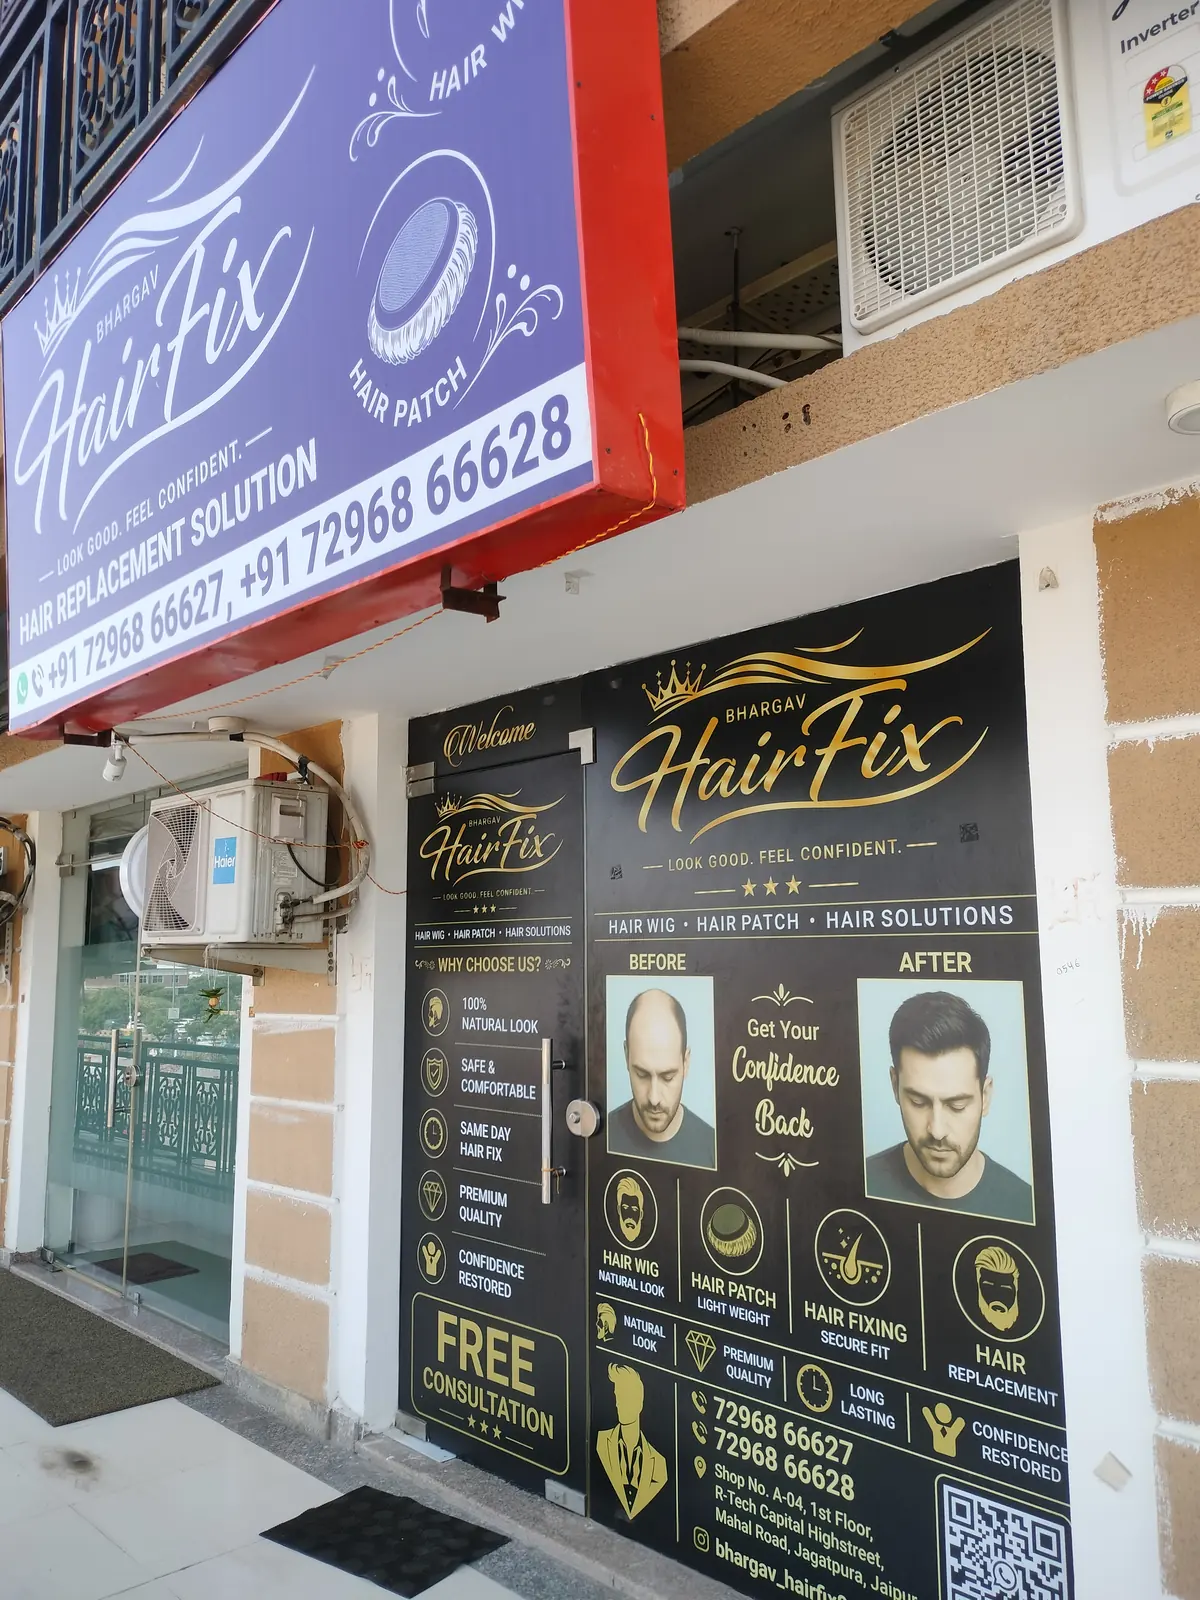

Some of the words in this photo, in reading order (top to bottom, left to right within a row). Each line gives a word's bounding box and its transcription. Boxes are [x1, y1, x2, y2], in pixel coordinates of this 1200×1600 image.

[1120, 0, 1200, 54] Inverter
[429, 43, 488, 102] HAIR
[96, 263, 159, 345] BHARGAV
[349, 358, 389, 424] HAIR
[393, 355, 468, 427] PATCH
[57, 543, 84, 577] LOOK
[87, 520, 122, 556] GOOD.
[126, 497, 153, 532] FEEL
[158, 439, 242, 509] CONFIDENT.
[19, 600, 53, 646] HAIR
[57, 516, 186, 625] REPLACEMENT
[191, 437, 317, 547] SOLUTION
[48, 645, 77, 689] +91
[83, 611, 144, 676] 72968
[150, 569, 232, 644] 66627,
[240, 536, 290, 599] +91
[301, 475, 414, 575] 72968
[426, 393, 572, 516] 66628
[725, 693, 806, 723] BHARGAV
[443, 705, 536, 768] Welcome
[468, 816, 501, 828] BHARGAV
[214, 854, 236, 869] Haier
[667, 856, 703, 872] LOOK
[708, 852, 755, 869] GOOD.
[759, 848, 795, 865] FEEL
[800, 838, 903, 862] CONFIDENT.
[443, 893, 458, 901] LOOK
[460, 892, 479, 900] GOOD.
[480, 890, 495, 898] FEEL
[495, 887, 534, 897] CONFIDENT.
[415, 931, 431, 941] HAIR
[431, 930, 445, 941] WIG
[453, 929, 471, 940] HAIR
[471, 927, 496, 939] PATCH
[505, 927, 524, 938] HAIR
[525, 925, 571, 937] SOLUTIONS
[608, 916, 644, 935] HAIR
[647, 916, 676, 934] WIG
[696, 914, 737, 933] HAIR
[741, 912, 800, 931] PATCH
[825, 907, 876, 930] HAIR
[880, 904, 1014, 929] SOLUTIONS
[438, 957, 464, 973] WHY
[466, 956, 515, 973] CHOOSE
[518, 955, 542, 972] US?
[628, 952, 687, 971] BEFORE
[898, 951, 973, 974] AFTER
[1056, 958, 1081, 976] 0546
[462, 996, 488, 1011] 100%
[462, 1017, 508, 1033] NATURAL
[509, 1019, 539, 1034] LOOK
[747, 1018, 775, 1039] Get
[779, 1020, 820, 1041] Your
[461, 1058, 486, 1074] SAFE
[487, 1060, 496, 1075] &
[732, 1045, 840, 1092] Confidence
[460, 1078, 536, 1101] COMFORTABLE
[460, 1120, 490, 1138] SAME
[490, 1125, 511, 1142] DAY
[755, 1098, 814, 1138] Back
[460, 1141, 485, 1159] HAIR
[486, 1145, 503, 1162] FIX
[459, 1184, 508, 1208] PREMIUM
[459, 1205, 503, 1228] QUALITY
[458, 1249, 525, 1280] CONFIDENCE
[603, 1249, 633, 1271] HAIR
[634, 1257, 660, 1278] WIG
[458, 1267, 512, 1299] RESTORED
[598, 1269, 639, 1291] NATURAL
[640, 1281, 665, 1298] LOOK
[691, 1271, 725, 1296] HAIR
[728, 1280, 777, 1309] PATCH
[623, 1314, 666, 1339] NATURAL
[697, 1296, 727, 1315] LIGHT
[728, 1304, 771, 1327] WEIGHT
[804, 1300, 844, 1327] HAIR
[849, 1311, 908, 1343] FIXING
[437, 1310, 535, 1397] FREE
[632, 1334, 657, 1352] LOOK
[723, 1345, 774, 1372] PREMIUM
[820, 1330, 869, 1355] SECURE
[871, 1342, 890, 1360] FIT
[975, 1343, 1027, 1375] HAIR
[726, 1364, 772, 1389] QUALITY
[948, 1364, 1059, 1408] REPLACEMENT
[422, 1366, 554, 1440] CONSULTATION
[850, 1383, 885, 1406] LONG
[713, 1395, 777, 1439] 72968
[783, 1421, 854, 1466] 66627
[841, 1400, 896, 1430] LASTING
[972, 1420, 1069, 1464] CONFIDENCE
[713, 1426, 778, 1472] 72968
[783, 1453, 855, 1501] 66628
[981, 1444, 1062, 1483] RESTORED
[714, 1463, 745, 1490] Shop
[748, 1475, 769, 1498] No.
[772, 1486, 807, 1515] A-04,
[810, 1501, 832, 1524] 1st
[834, 1510, 874, 1543] Floor,
[715, 1484, 757, 1515] R-Tech
[759, 1504, 805, 1536] Capital
[807, 1522, 885, 1572] Highstreet,
[715, 1507, 752, 1536] Mahal
[755, 1523, 791, 1555] Road,
[794, 1542, 867, 1590] Jagatpura,
